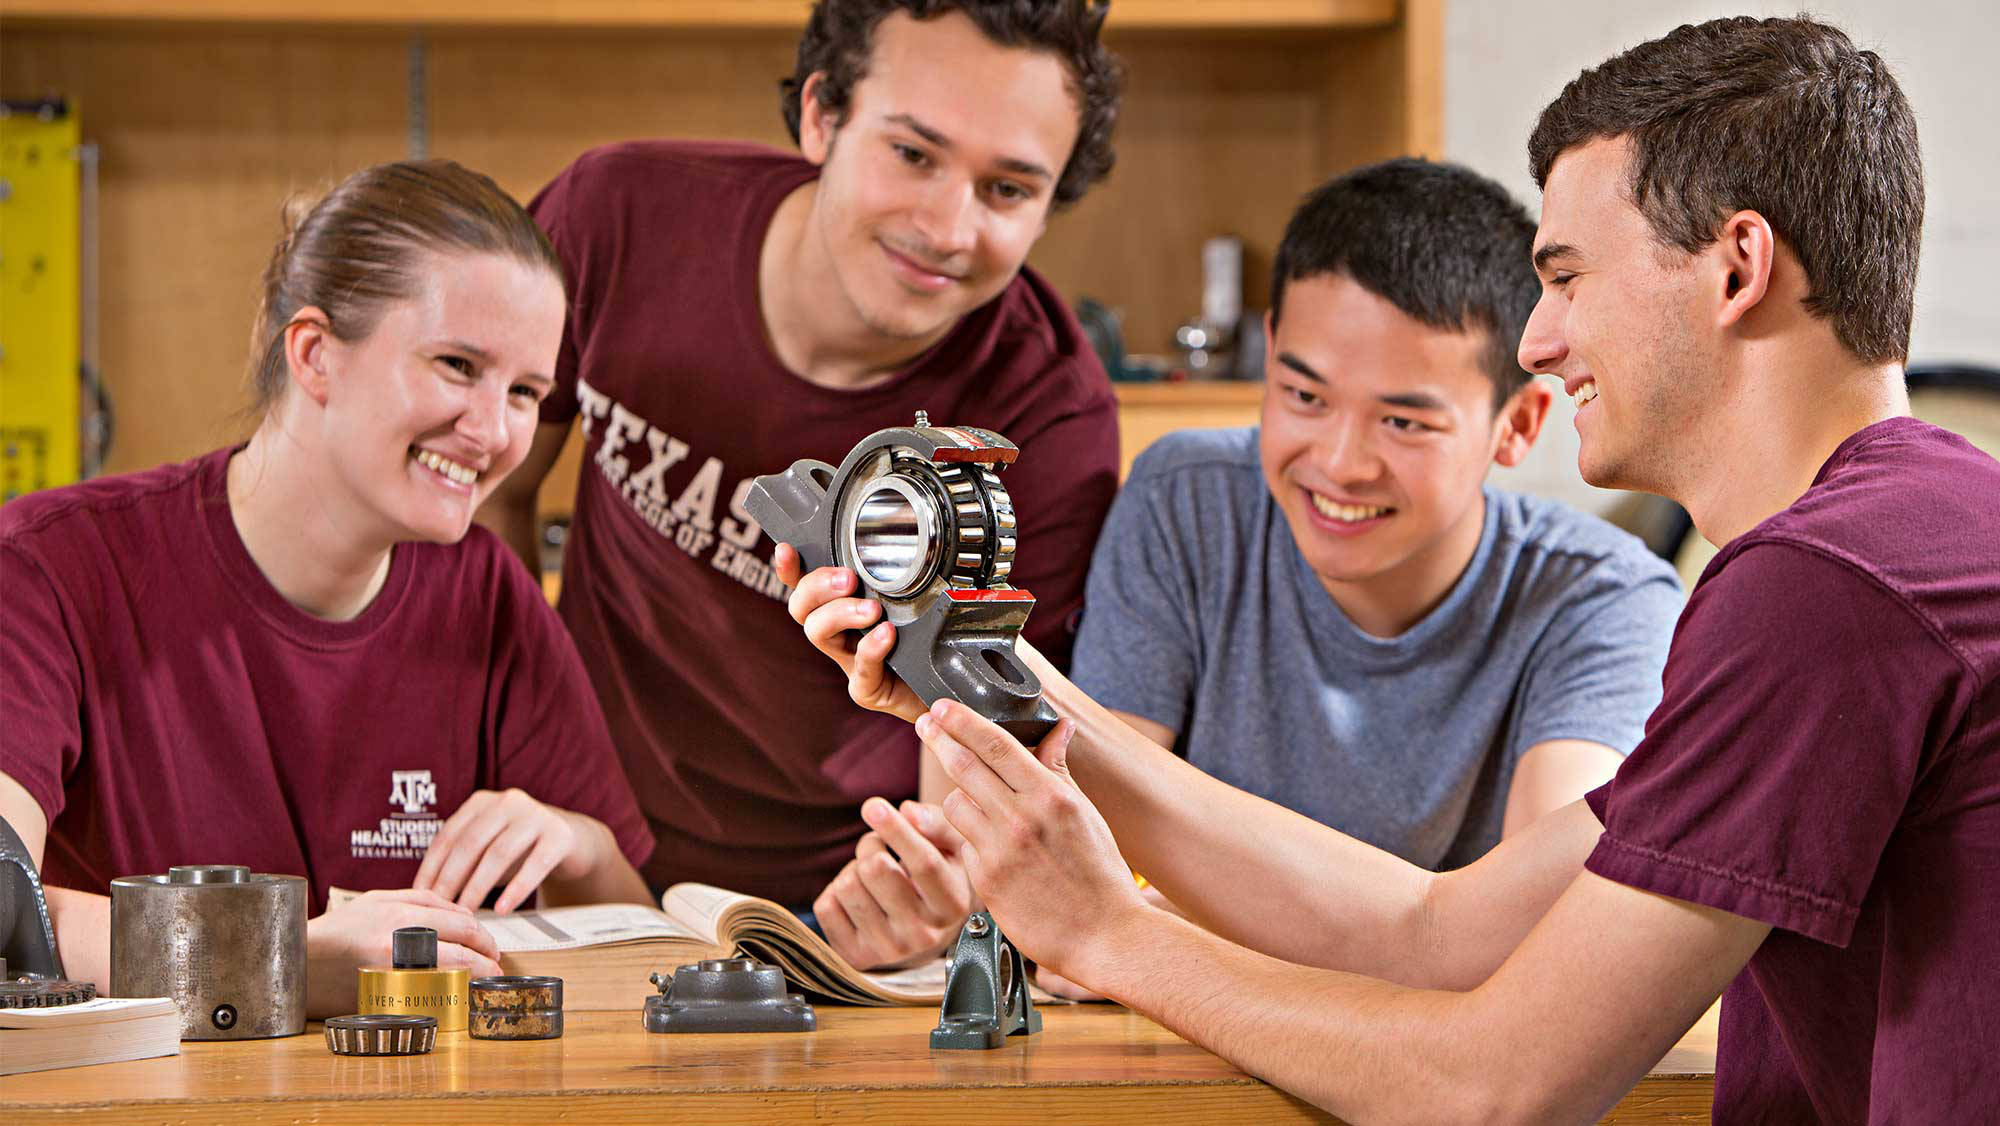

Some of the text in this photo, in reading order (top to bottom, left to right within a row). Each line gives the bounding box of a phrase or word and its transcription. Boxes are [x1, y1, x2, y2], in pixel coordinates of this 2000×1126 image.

[576, 377, 761, 550] TEXAS
[675, 522, 714, 558] OF
[380, 818, 444, 833] STUDENT
[351, 829, 407, 847] HEALTH
[352, 846, 387, 858] TEXAS
[188, 938, 200, 986] BEFORE
[368, 994, 458, 1008] OVER-RUNNING
